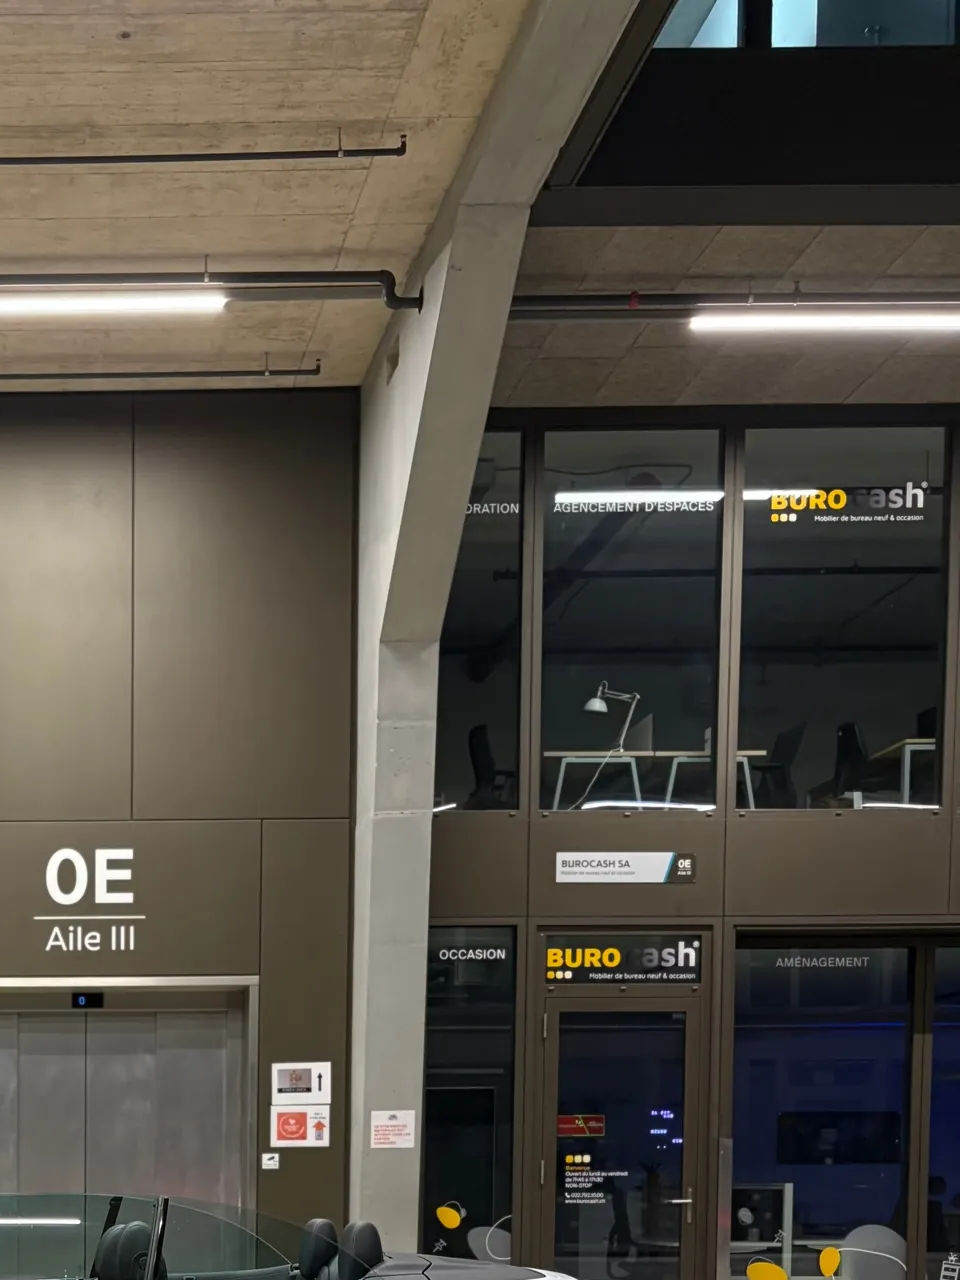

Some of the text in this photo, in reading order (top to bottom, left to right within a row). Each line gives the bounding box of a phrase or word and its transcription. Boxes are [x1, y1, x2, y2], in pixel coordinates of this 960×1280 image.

[553, 500, 715, 513] AGENCEMENT D'ESPACES
[814, 514, 839, 522] Mobilier
[561, 860, 631, 868] BUROCASH SA
[45, 925, 101, 951] Aile
[439, 948, 506, 960] OCCASION
[546, 948, 621, 967] BURO
[775, 956, 870, 967] AMÉNAGEMENT
